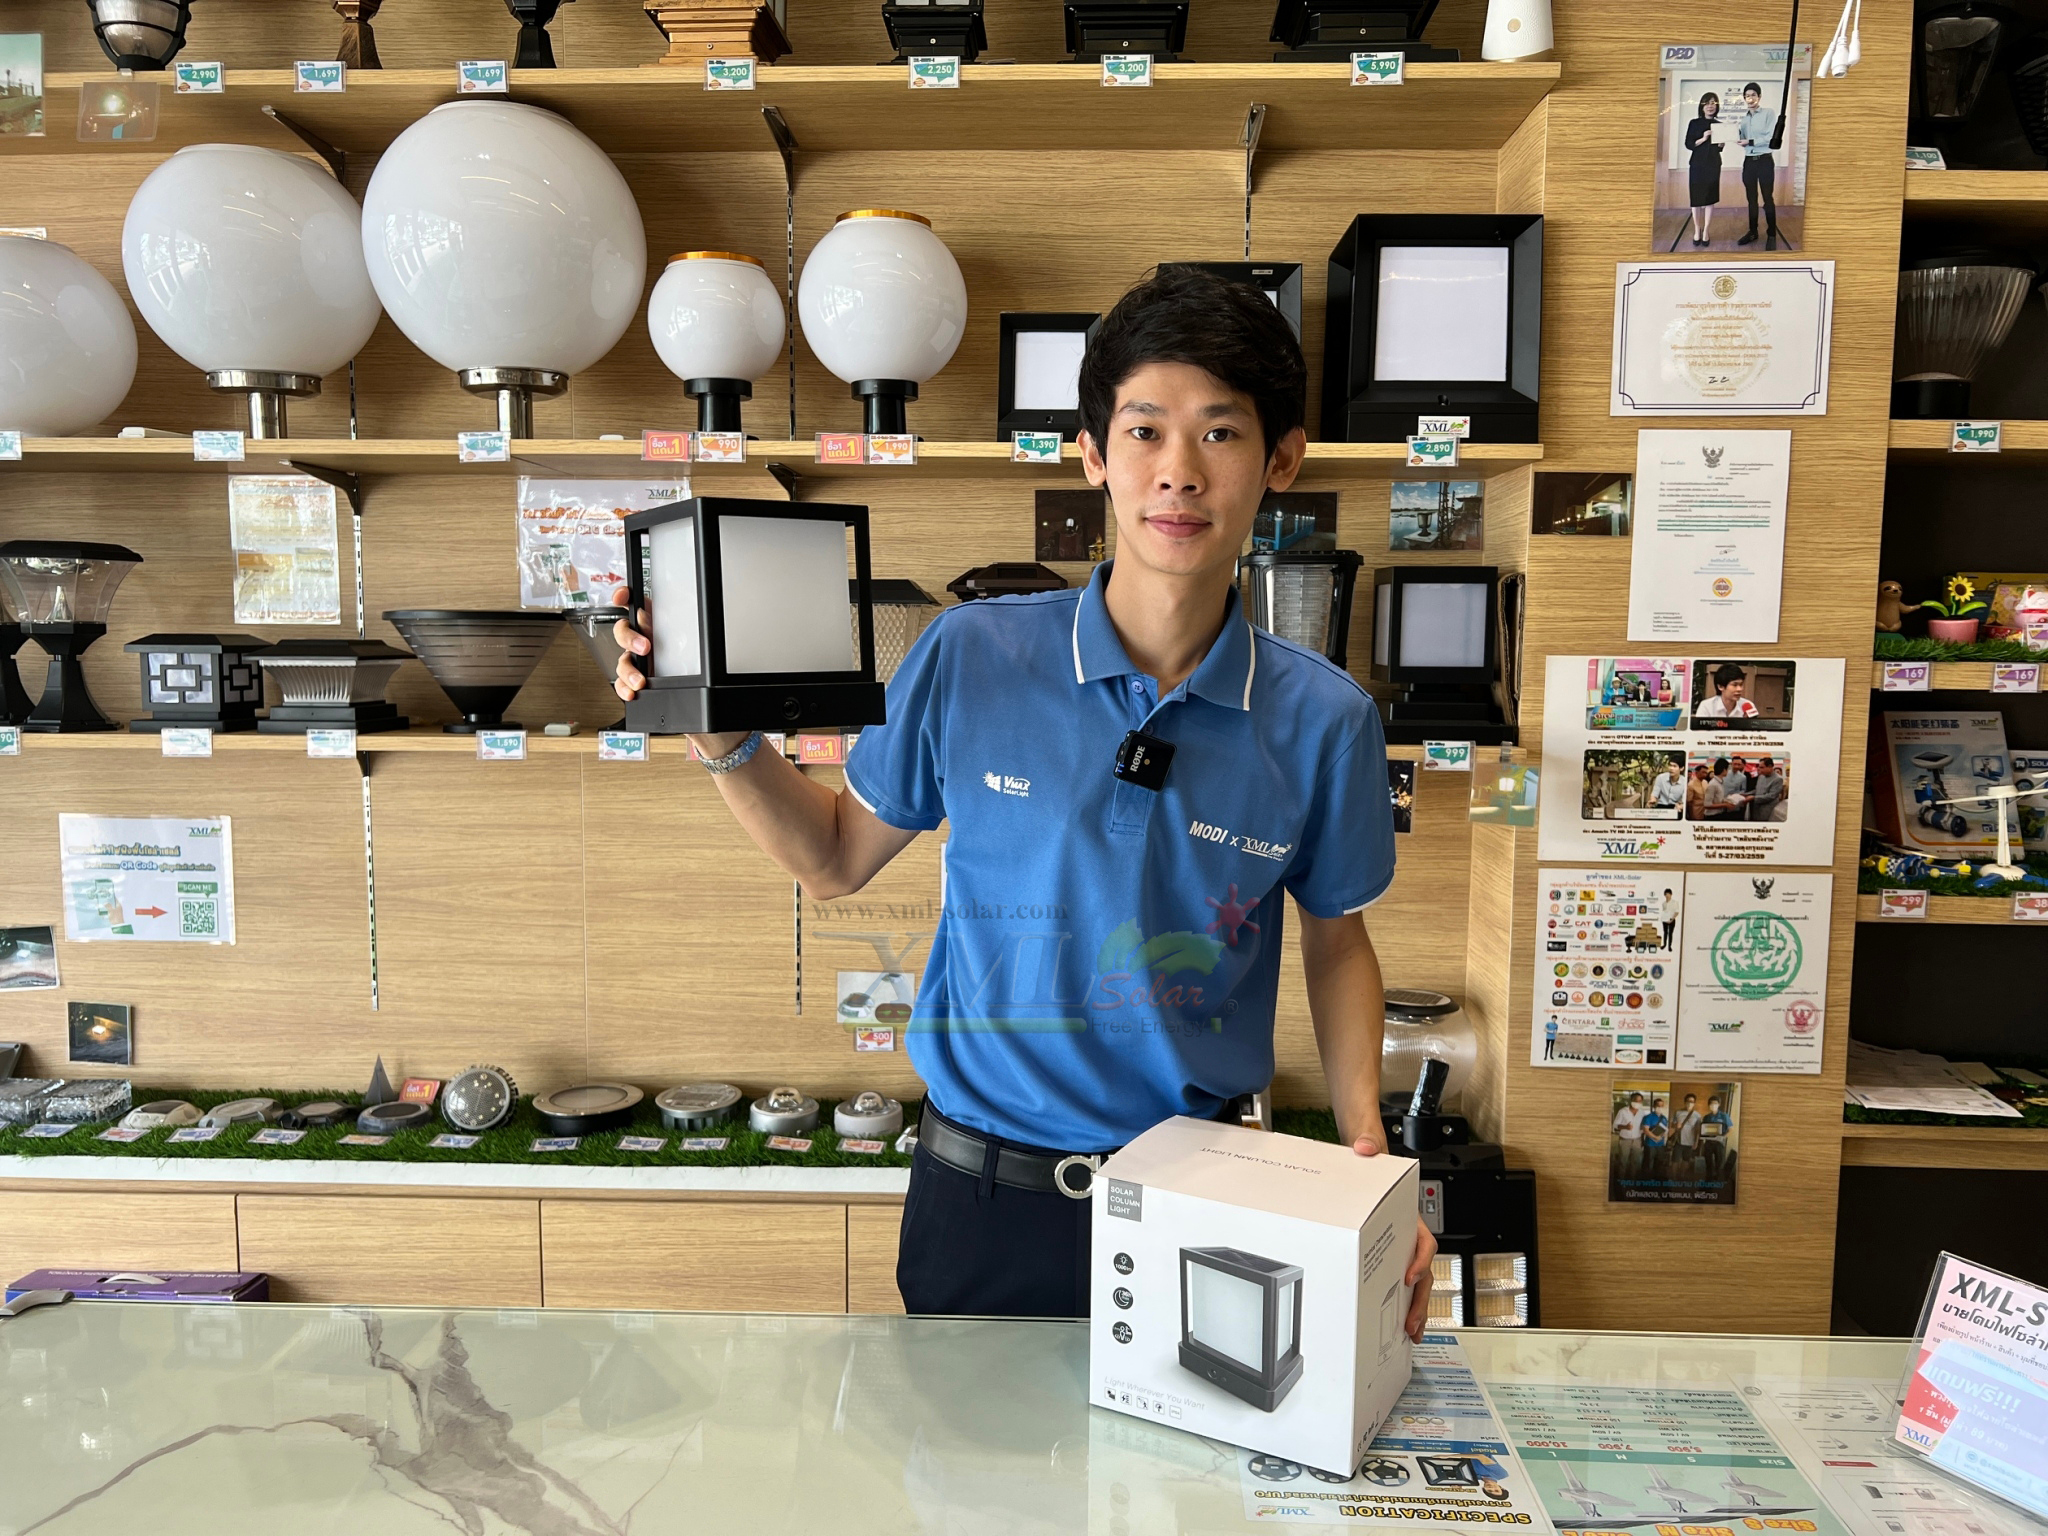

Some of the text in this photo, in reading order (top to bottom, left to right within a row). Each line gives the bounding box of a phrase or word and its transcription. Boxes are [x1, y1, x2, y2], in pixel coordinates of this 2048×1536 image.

[1665, 47, 1695, 60] DBD
[927, 65, 952, 77] 2,250
[1119, 62, 1144, 75] 3,200
[1370, 60, 1396, 72] 5,990
[192, 69, 216, 81] 2,990
[315, 69, 337, 80] 1,699
[478, 69, 501, 80] 1,699
[723, 67, 748, 79] 3,200
[1424, 422, 1453, 433] XML
[1970, 430, 1995, 440] 1,990
[478, 440, 500, 450] 1,490
[719, 440, 738, 449] 990
[885, 441, 909, 452] 1,990
[1031, 439, 1055, 451] 1,390
[1425, 443, 1450, 454] 2,890
[1904, 669, 1924, 680] 169
[2014, 670, 2034, 681] 169
[496, 738, 519, 748] 1,590
[618, 739, 640, 750] 1,490
[1445, 748, 1465, 758] 999
[1189, 820, 1229, 844] MODI
[1241, 836, 1271, 854] XML
[1597, 841, 1640, 855] XML
[120, 861, 159, 870] QR Code
[182, 883, 201, 891] SCAN
[1900, 896, 1921, 906] 299
[872, 1032, 890, 1040] 500
[1200, 1147, 1322, 1175] SOLAR COLUMN LIGHT
[1110, 1186, 1134, 1197] SOLAR
[1110, 1195, 1141, 1208] COLUMN
[1109, 1204, 1131, 1215] LIGHT
[1947, 1272, 2048, 1327] XML-S
[1997, 1344, 2015, 1358] สินค้า
[1104, 1376, 1206, 1410] Light Wherever You Want
[1925, 1365, 2022, 1413] แถมฟรี!!!
[1901, 1424, 1932, 1447] XML
[1970, 1427, 1985, 1440] 89
[1470, 1446, 1499, 1455] Model
[1526, 1440, 1702, 1453] 5,900 7,900 10,000
[1254, 1488, 1281, 1500] UFO
[1278, 1506, 1310, 1518] XML
[1338, 1505, 1532, 1525] SPECIFICATION
[1655, 1525, 1681, 1536] M
[1681, 1525, 1735, 1536] Size
[1742, 1518, 1818, 1532] Size S
